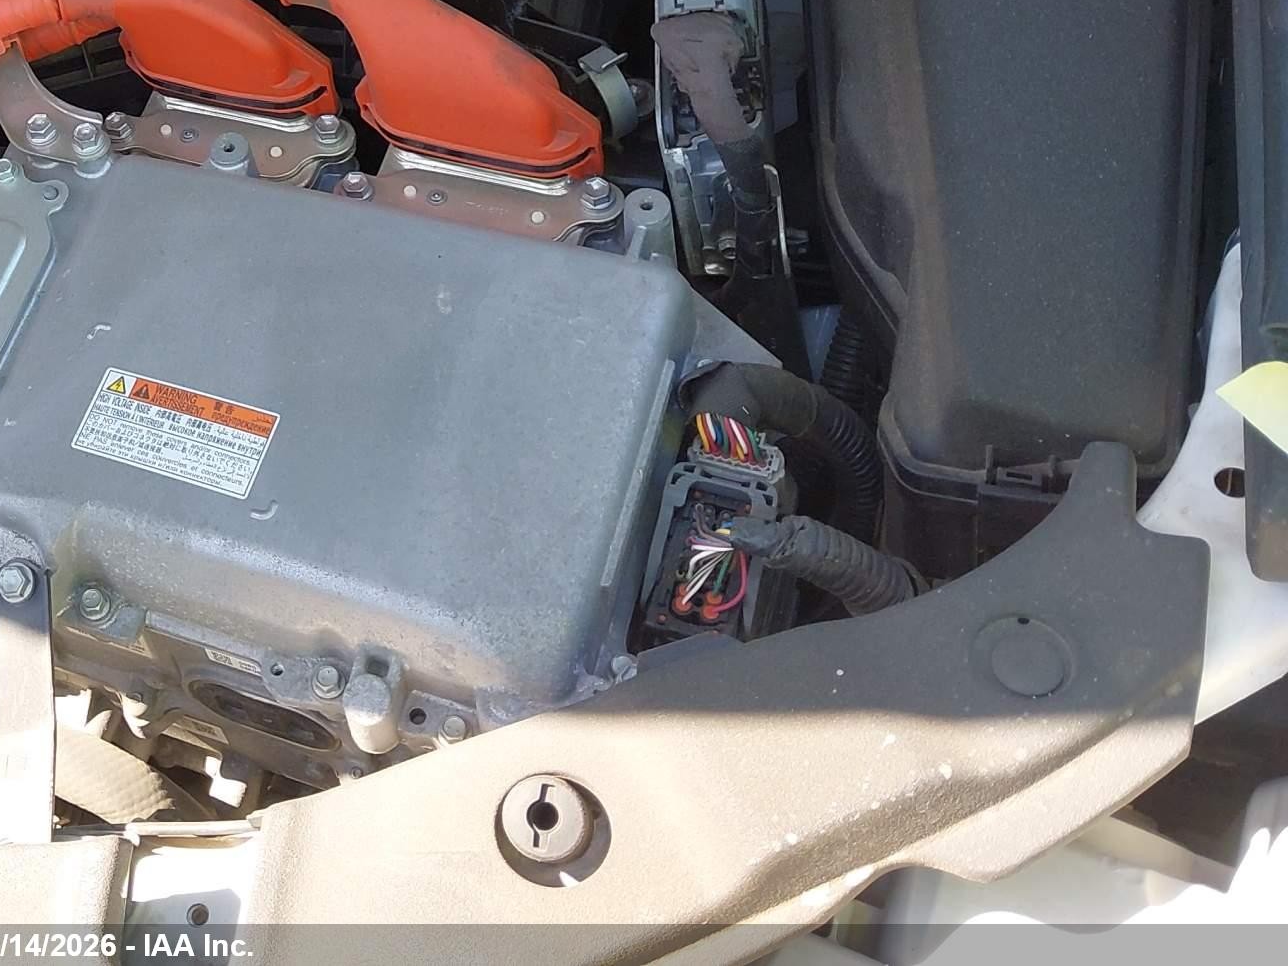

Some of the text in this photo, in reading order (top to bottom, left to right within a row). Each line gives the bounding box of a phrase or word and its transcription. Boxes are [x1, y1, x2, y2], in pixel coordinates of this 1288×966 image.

[97, 393, 112, 403] HIGH
[111, 396, 135, 410] VOLTAGE
[134, 403, 152, 415] INSIDE
[155, 384, 199, 404] WARNING
[93, 403, 111, 413] HAUTE
[110, 408, 131, 419] TENSION
[150, 394, 205, 417] AVERTISSEMENT
[102, 417, 117, 425] NOT
[120, 423, 143, 433] remove
[146, 430, 164, 439] these
[166, 436, 188, 446] covers
[80, 432, 91, 440] NE
[93, 436, 108, 445] PAS
[110, 441, 134, 453] enlever
[151, 454, 188, 469] couvercles
